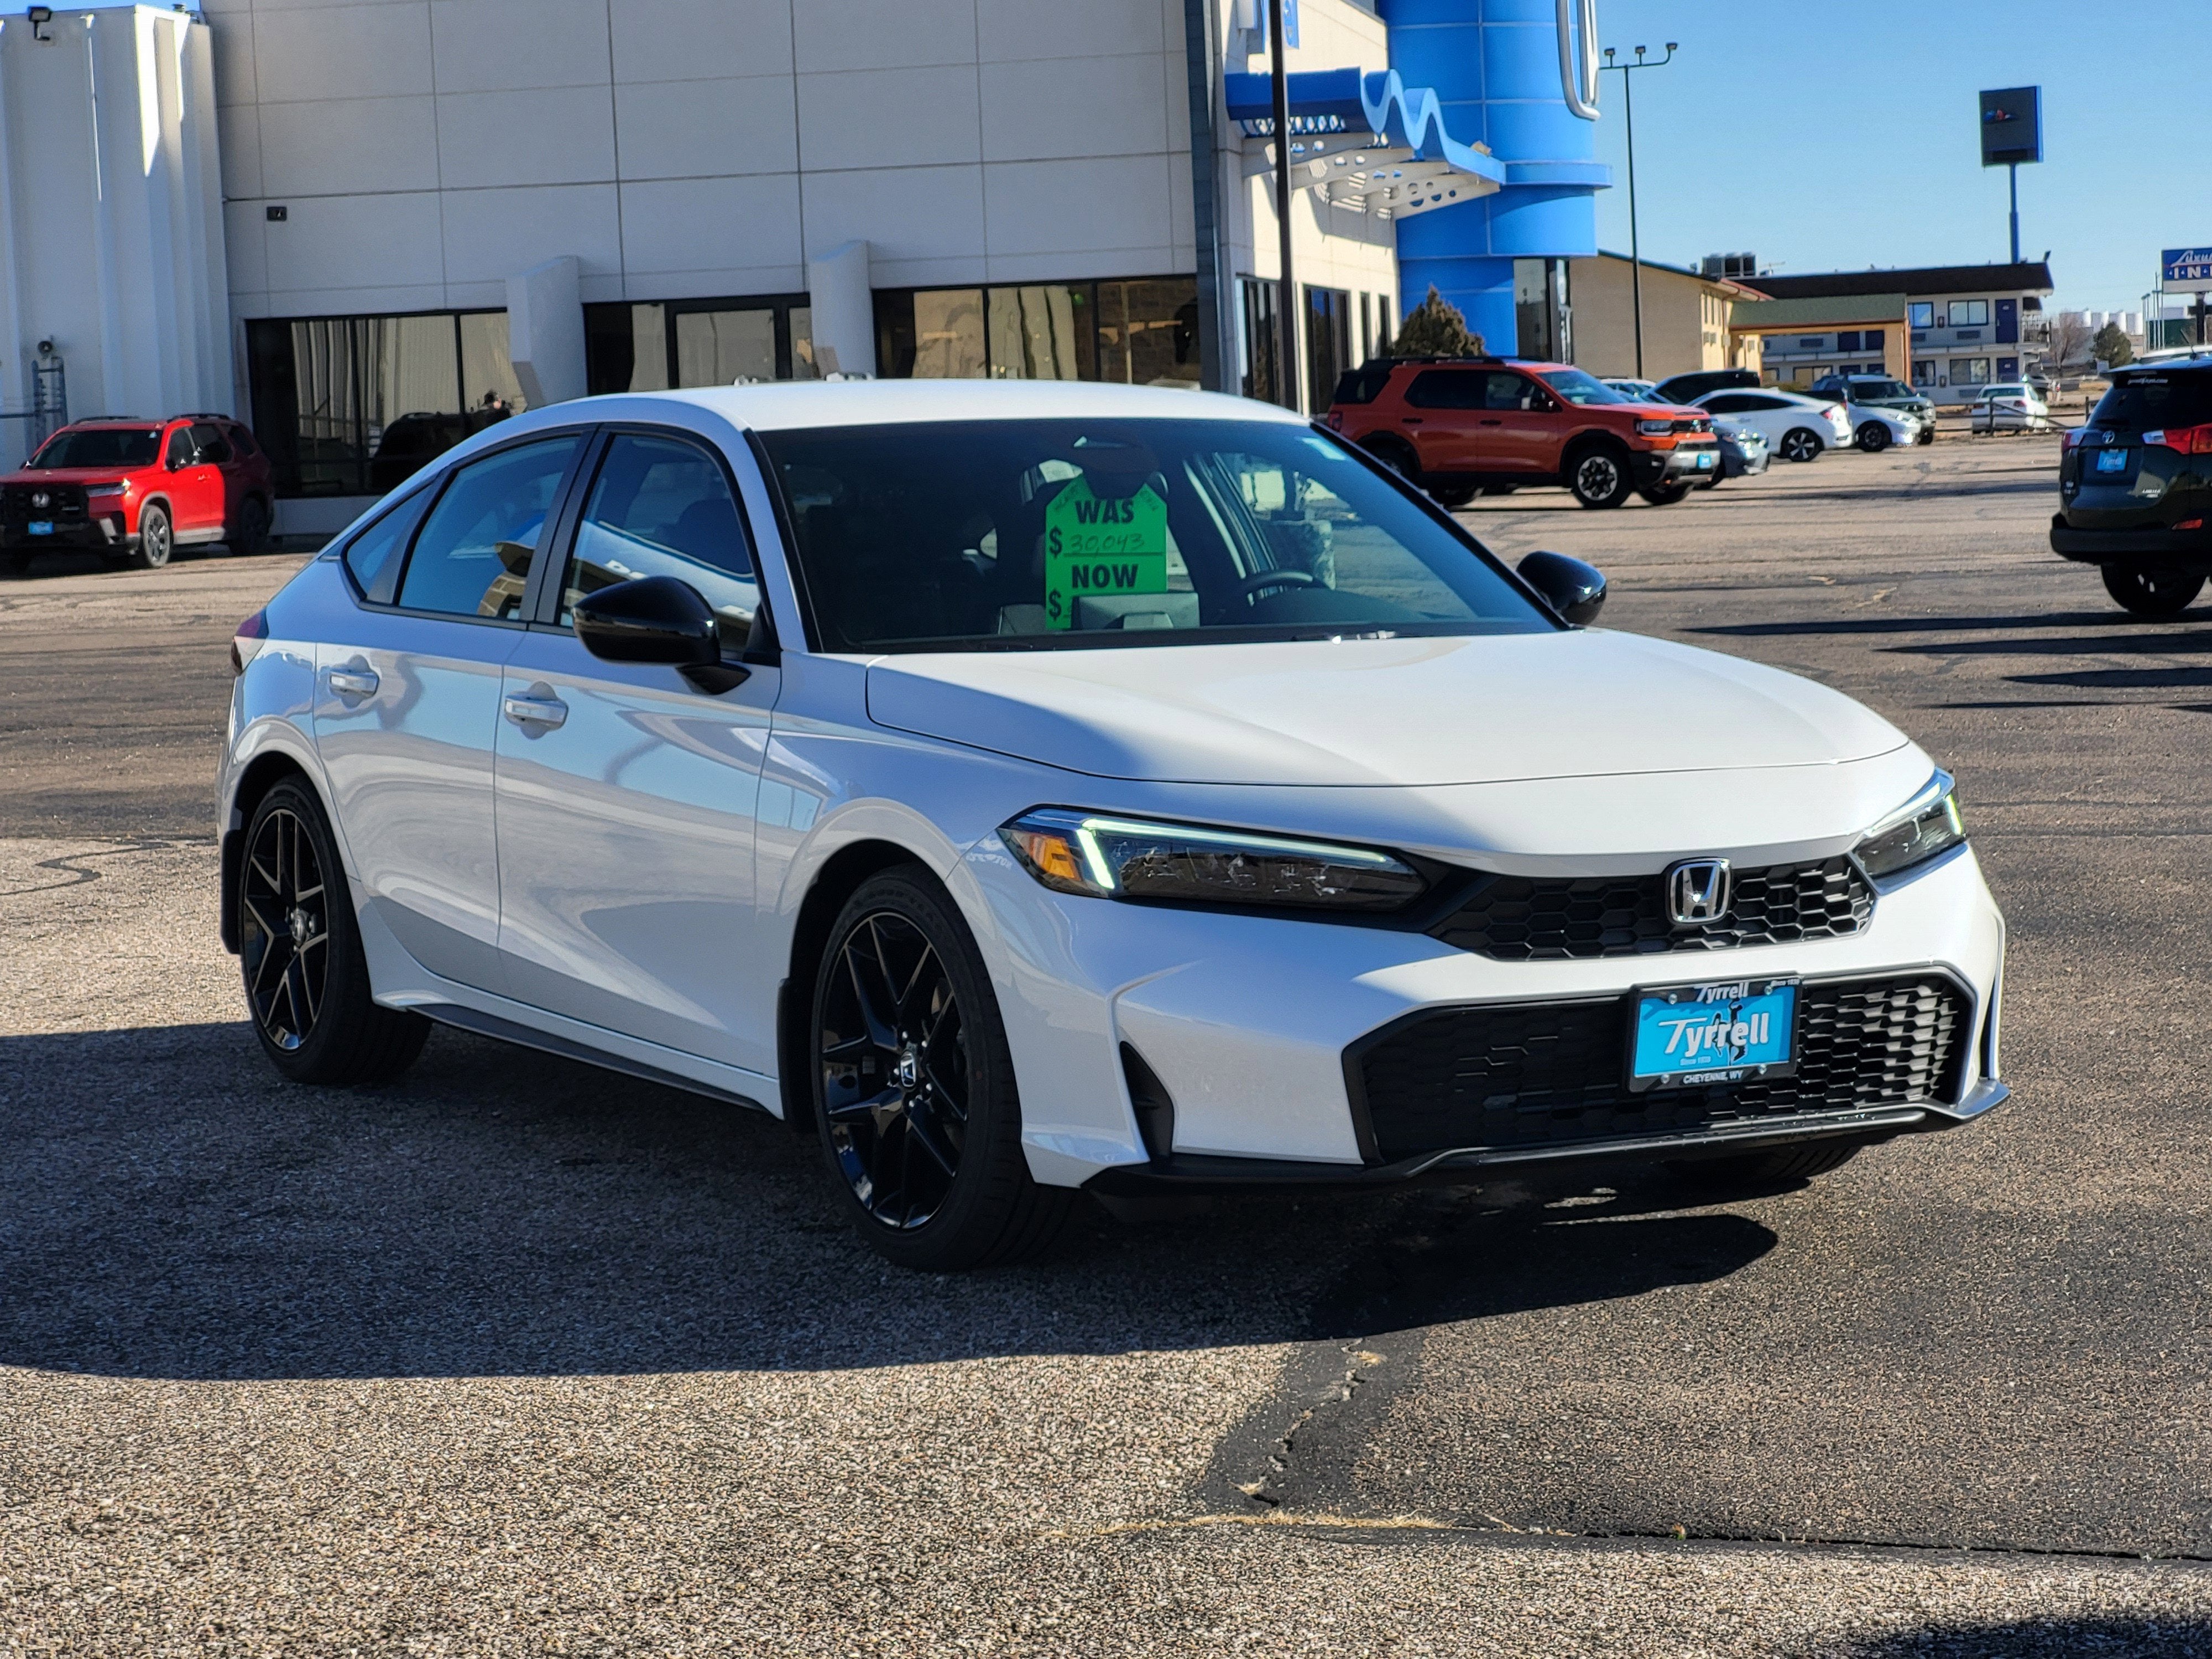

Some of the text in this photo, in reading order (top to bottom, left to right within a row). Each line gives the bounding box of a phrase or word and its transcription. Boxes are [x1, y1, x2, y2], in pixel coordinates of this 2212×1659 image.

[2174, 265, 2212, 279] IN
[1076, 499, 1134, 524] WAS
[1049, 526, 1063, 559] $
[1072, 565, 1138, 588] NOW
[1048, 589, 1062, 622] $
[1694, 982, 1750, 1004] Tyrrell
[1658, 1013, 1769, 1057] Tyrrell
[1729, 1070, 1744, 1079] WY
